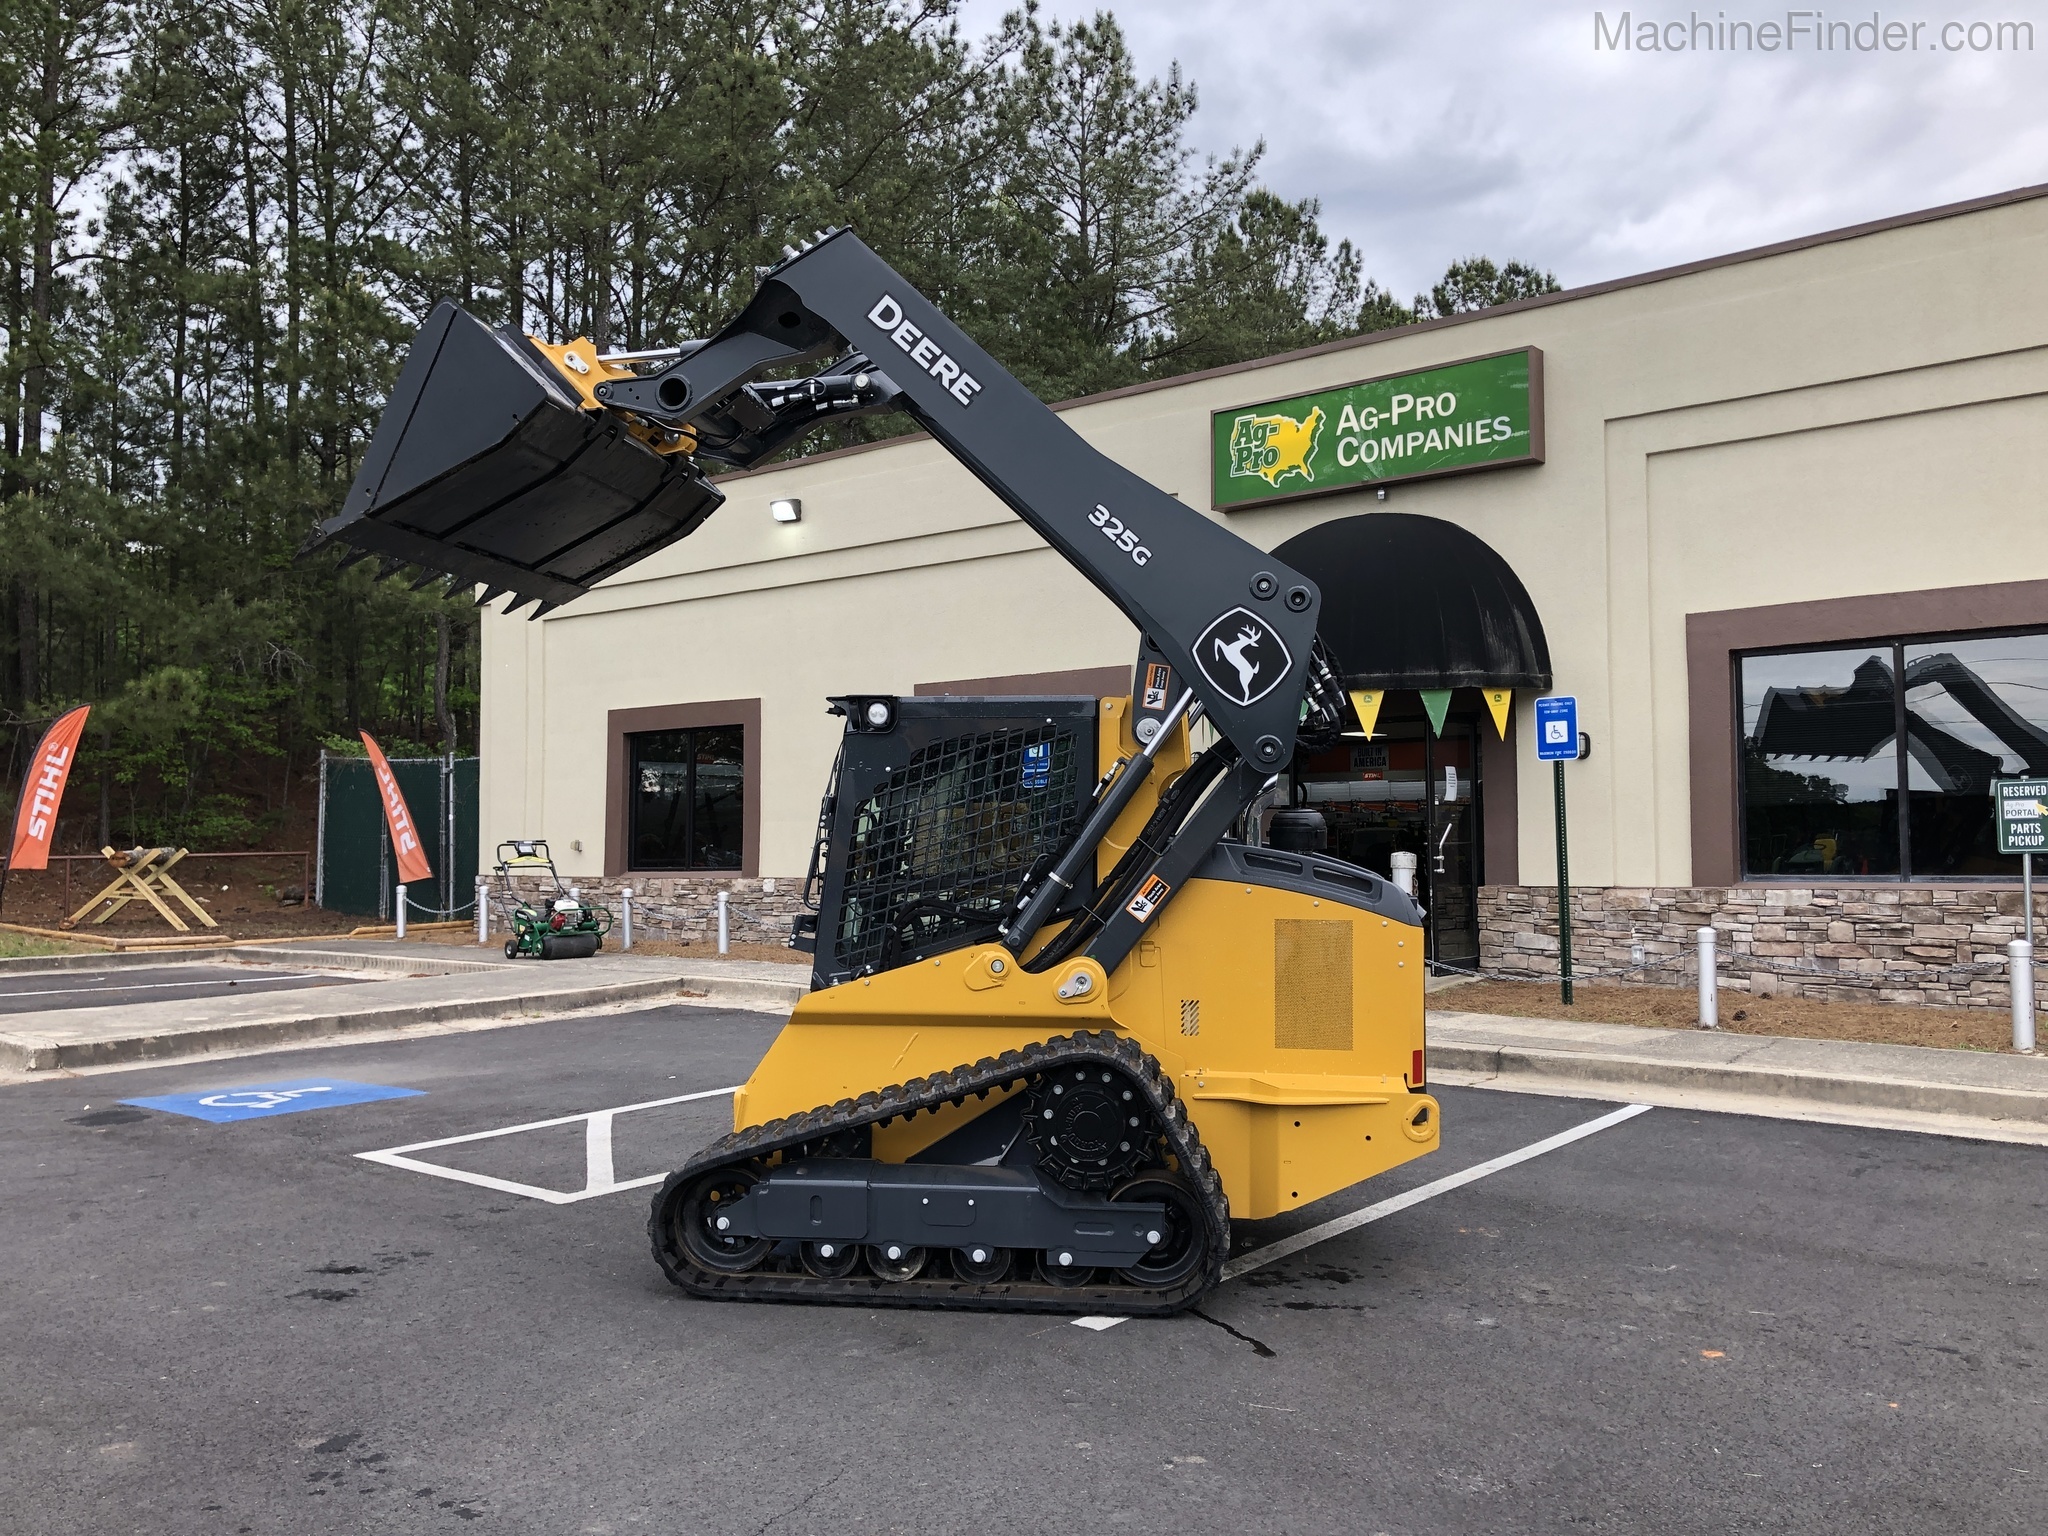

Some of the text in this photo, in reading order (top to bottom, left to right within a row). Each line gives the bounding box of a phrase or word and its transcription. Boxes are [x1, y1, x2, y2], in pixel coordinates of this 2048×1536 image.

[867, 294, 982, 406] DEERE
[1232, 446, 1280, 475] Pro
[1087, 504, 1152, 567] 325G
[1357, 747, 1383, 757] BUILT IN
[1353, 757, 1387, 768] AMERICA
[2002, 785, 2047, 797] RESERVED
[2005, 809, 2037, 817] PORTAL
[2010, 823, 2042, 834] PARTS
[2008, 835, 2045, 847] PICKUP
